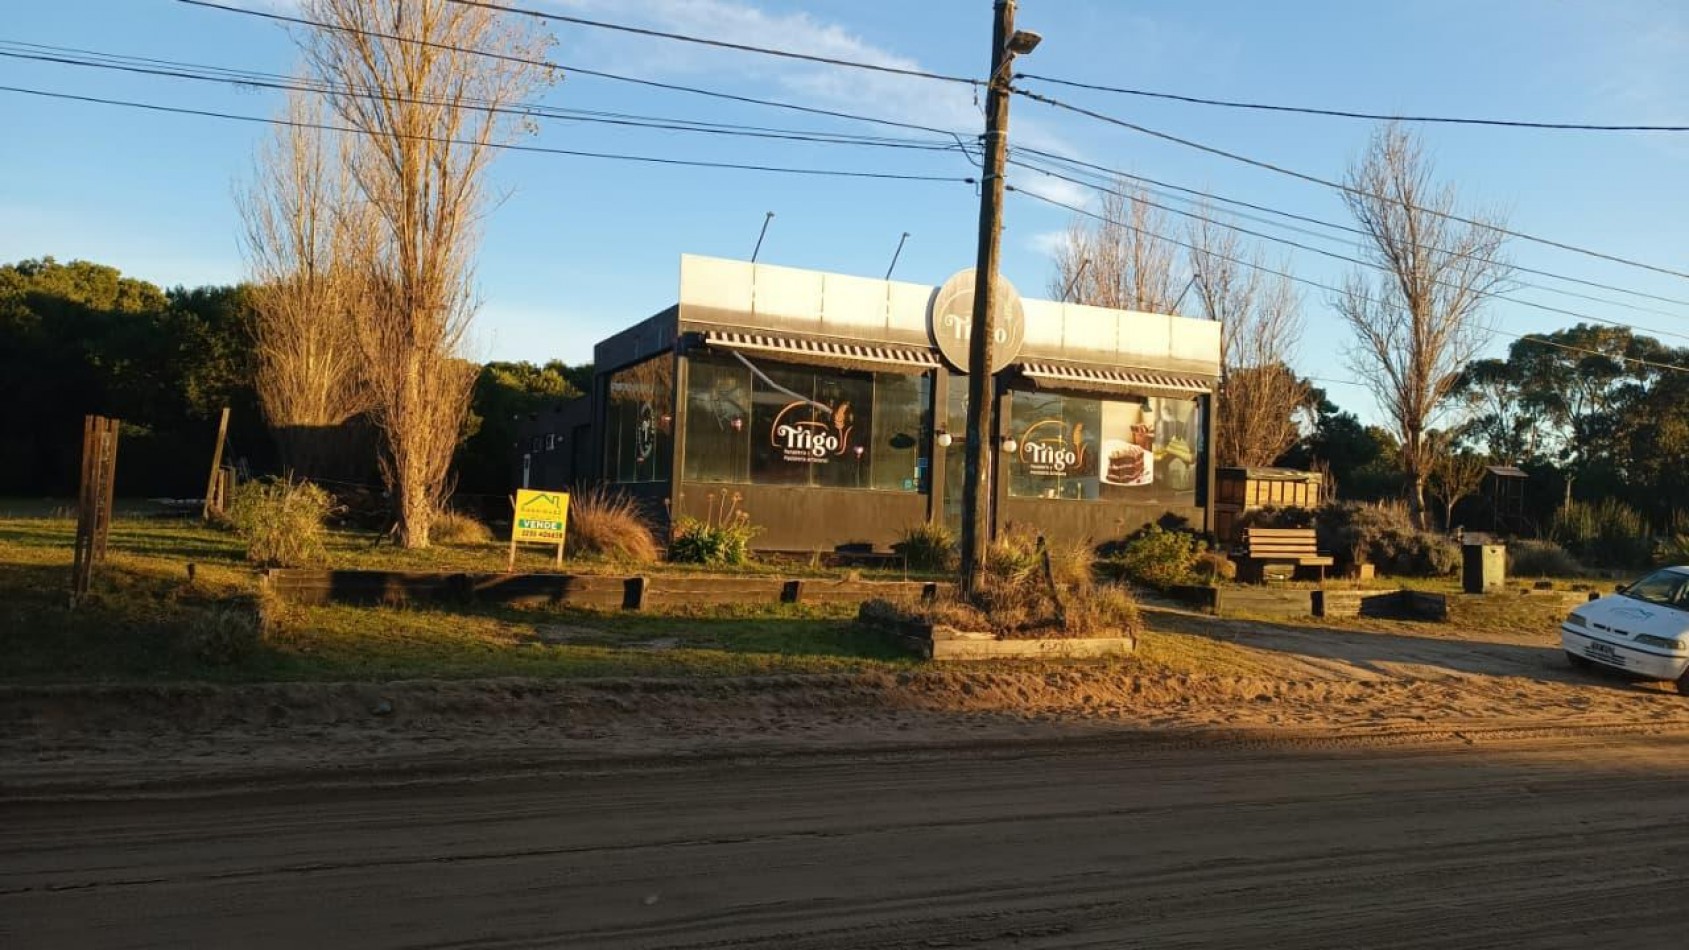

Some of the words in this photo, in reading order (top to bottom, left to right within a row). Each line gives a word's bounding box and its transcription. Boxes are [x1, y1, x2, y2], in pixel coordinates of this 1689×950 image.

[945, 314, 1006, 344] Tro
[777, 425, 838, 457] Trigo
[1024, 442, 1076, 471] Trigo
[524, 520, 558, 530] VENDE
